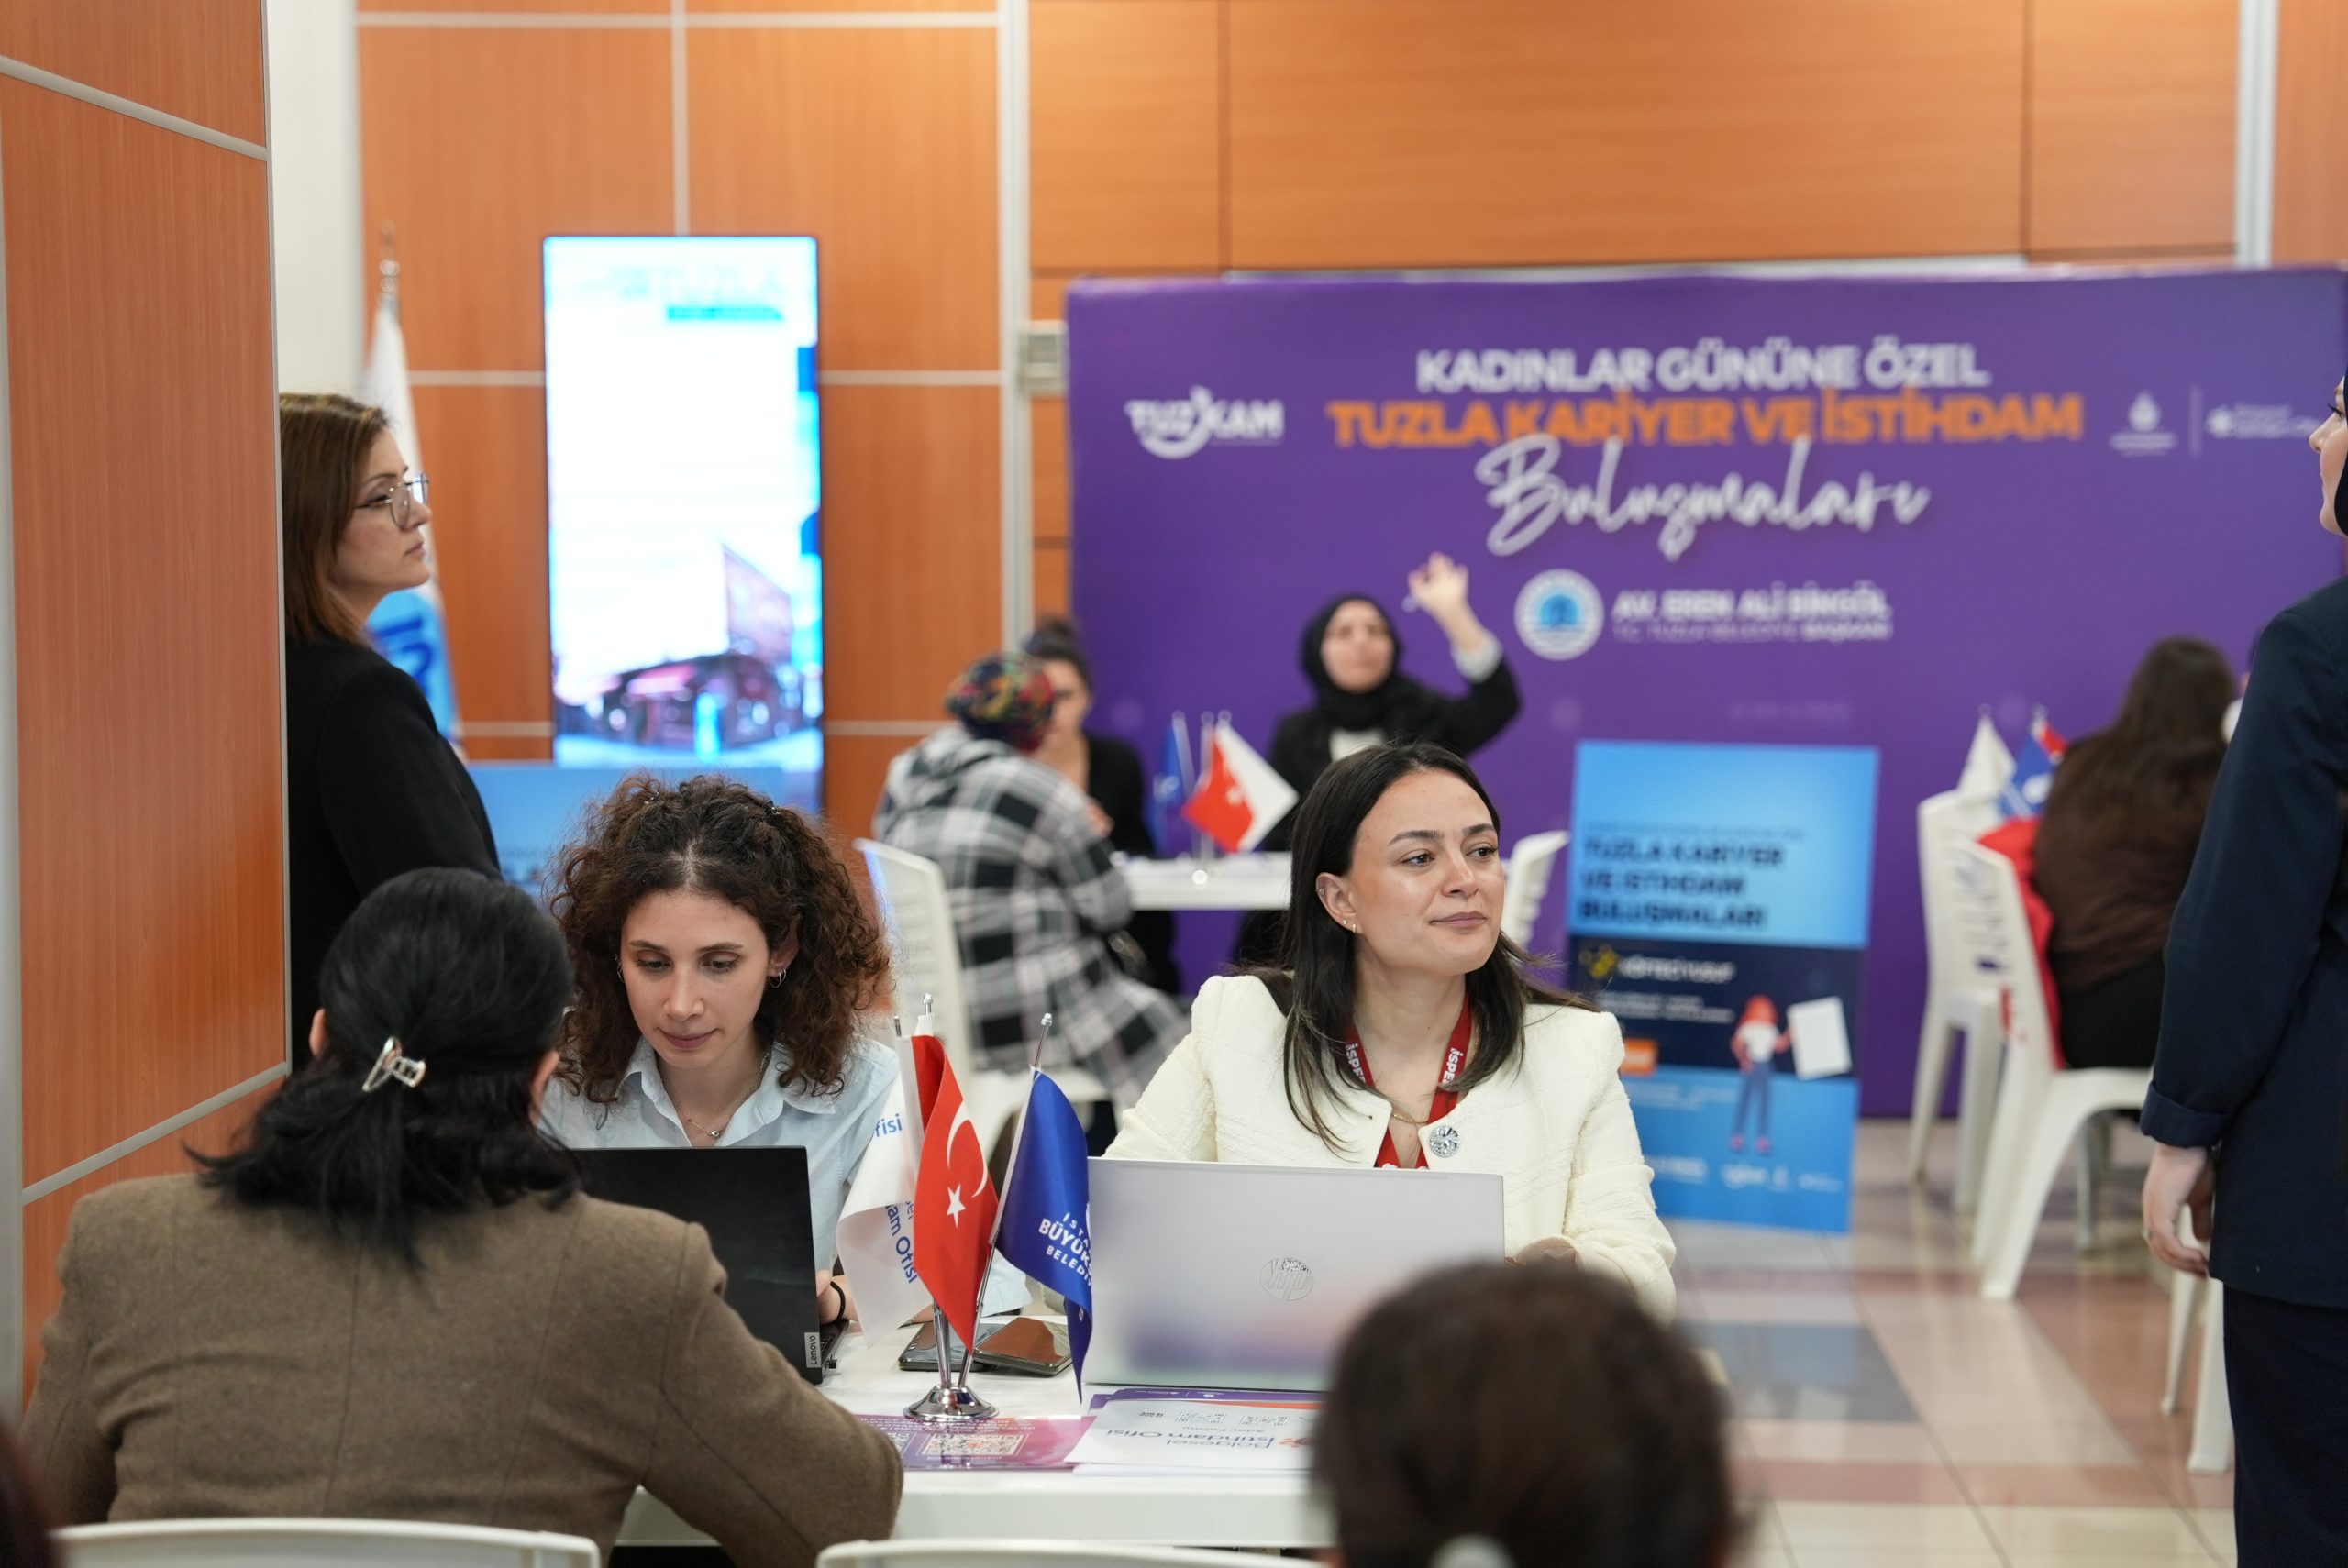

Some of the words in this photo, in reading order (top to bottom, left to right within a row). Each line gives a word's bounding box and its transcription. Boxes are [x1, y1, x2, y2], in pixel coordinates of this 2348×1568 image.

[1415, 348, 1653, 392] KADINLAR
[1656, 336, 1862, 391] GÜNÜNE
[1864, 334, 1991, 388] ÖZEL
[1325, 400, 1501, 448] TUZLA
[1504, 390, 1736, 446] KARİYER
[1743, 397, 1816, 442] VE
[1820, 386, 2085, 442] İSTİHDAM
[1584, 839, 1661, 863] TUZLA
[875, 1113, 903, 1137] fisi
[809, 1335, 818, 1365] Lenovo
